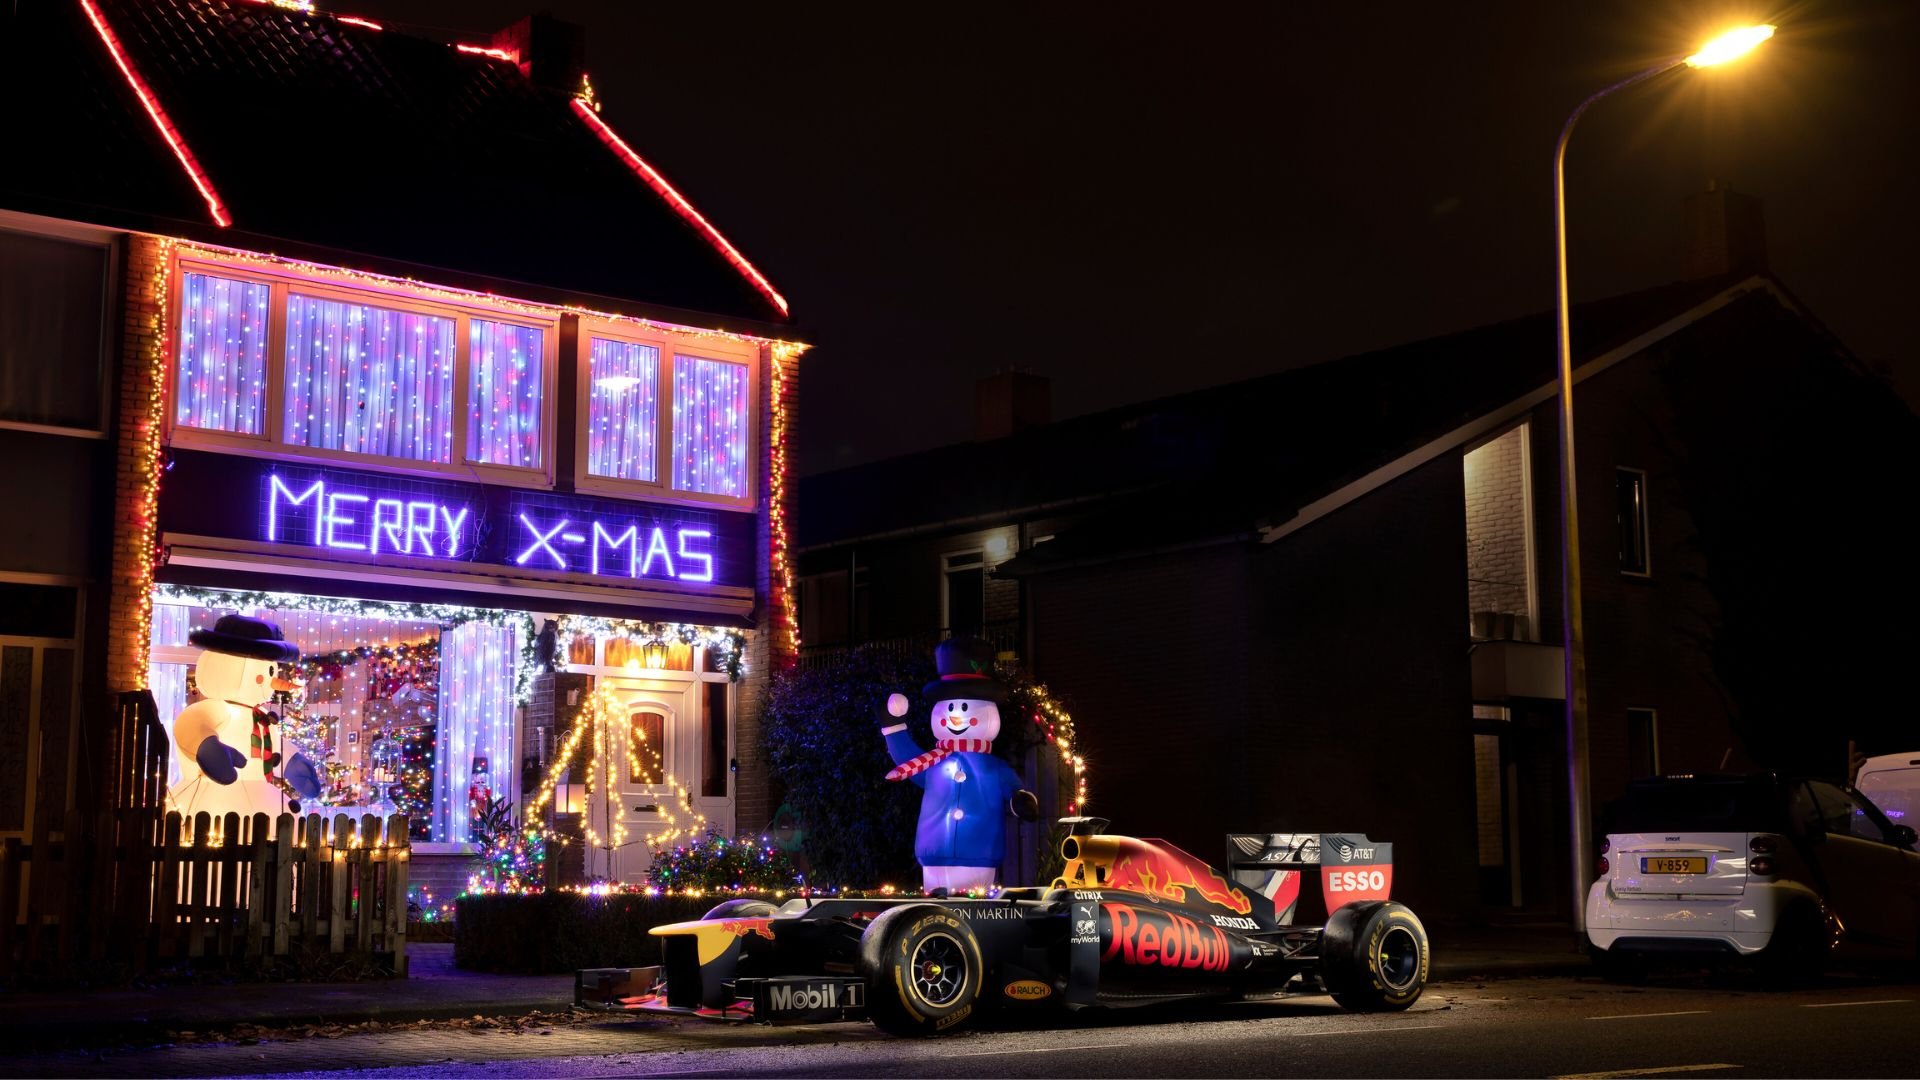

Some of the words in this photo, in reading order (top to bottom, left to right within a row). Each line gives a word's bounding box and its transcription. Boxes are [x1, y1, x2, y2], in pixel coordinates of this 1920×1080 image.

[269, 474, 468, 559] MERRY
[516, 512, 713, 583] X-MAS
[1353, 848, 1375, 860] AT&T
[1656, 860, 1689, 871] V-859
[1329, 871, 1385, 892] ESSO
[976, 907, 1023, 920] MARTIN
[911, 914, 960, 937] ZERO
[1210, 914, 1261, 930] HONDA
[1071, 936, 1100, 944] myWorld
[770, 984, 836, 1010] Mobil
[847, 985, 857, 1006] 1
[1016, 985, 1046, 995] RAUCH
